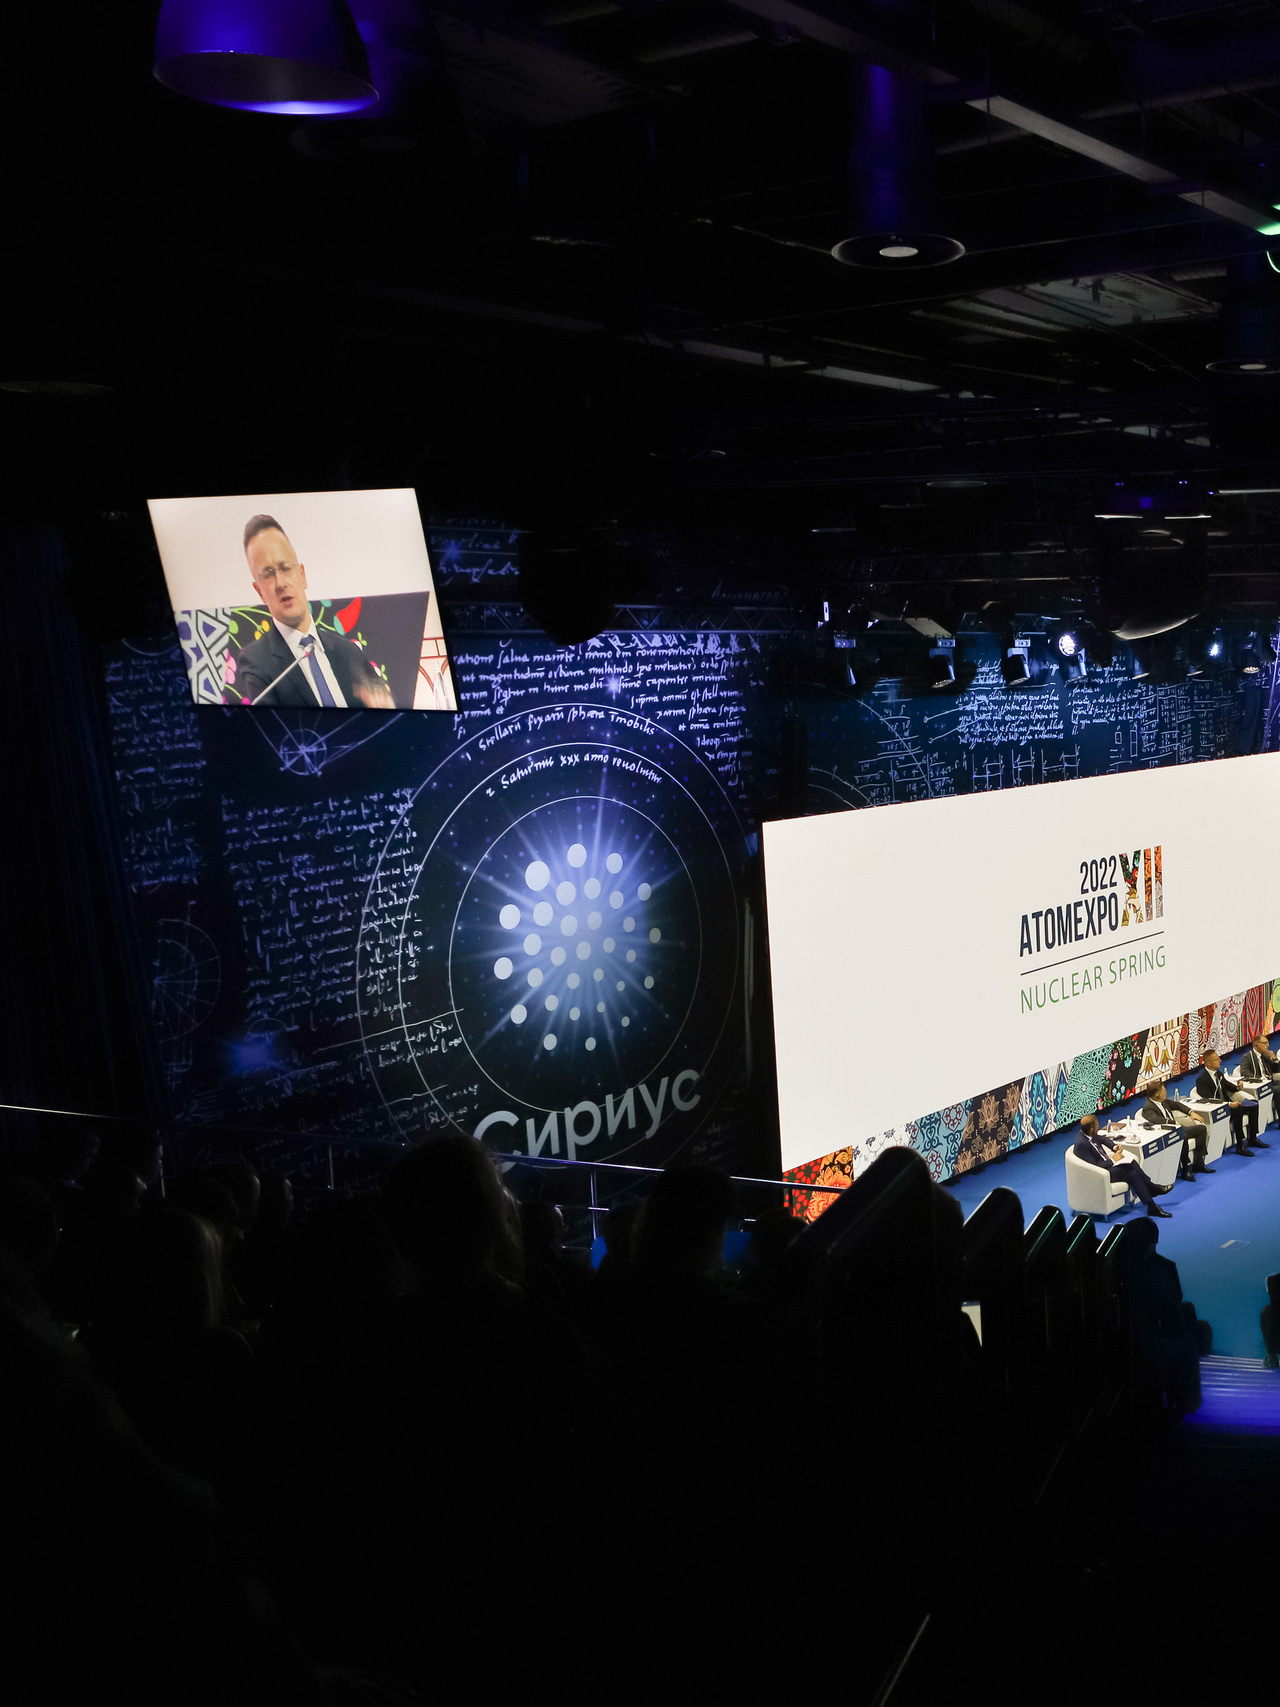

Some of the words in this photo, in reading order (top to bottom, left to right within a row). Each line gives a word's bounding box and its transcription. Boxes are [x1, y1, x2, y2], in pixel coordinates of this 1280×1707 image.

[1019, 892, 1119, 957] ATOMEXPO
[1118, 845, 1164, 927] XII
[1080, 855, 1118, 895] 2022
[1020, 965, 1104, 1014] NUCLEAR
[1109, 945, 1167, 984] SPRING
[473, 1069, 701, 1174] Сириус
